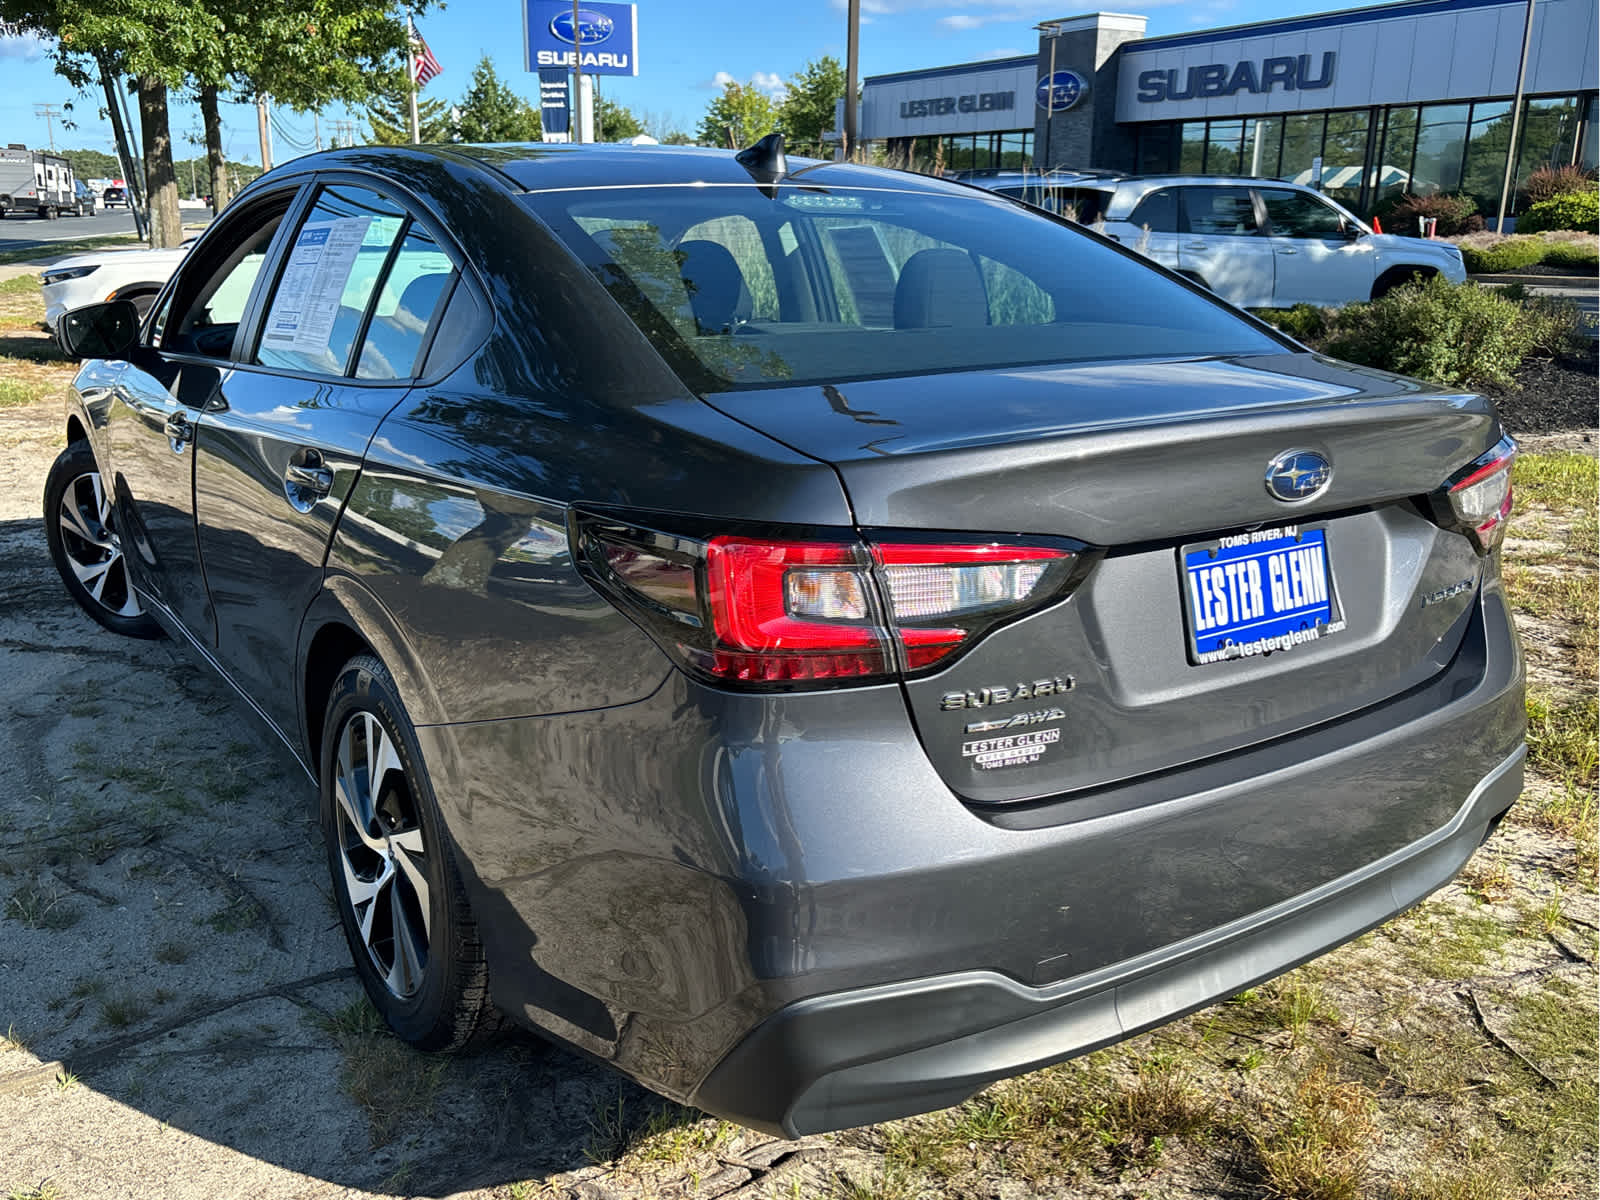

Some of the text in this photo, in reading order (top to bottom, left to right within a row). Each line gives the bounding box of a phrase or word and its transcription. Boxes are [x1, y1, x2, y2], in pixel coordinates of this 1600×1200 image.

[537, 51, 628, 68] SUBARU
[1137, 51, 1337, 103] SUBARU
[900, 91, 1015, 118] LESTER GLENN
[1219, 534, 1250, 550] TOMS
[1284, 525, 1298, 537] NJ
[1188, 546, 1327, 631] LESTER GLENN
[940, 675, 1076, 711] SUBARU
[962, 729, 1060, 755] LESTER GLENN
[982, 760, 1003, 769] TOMS
